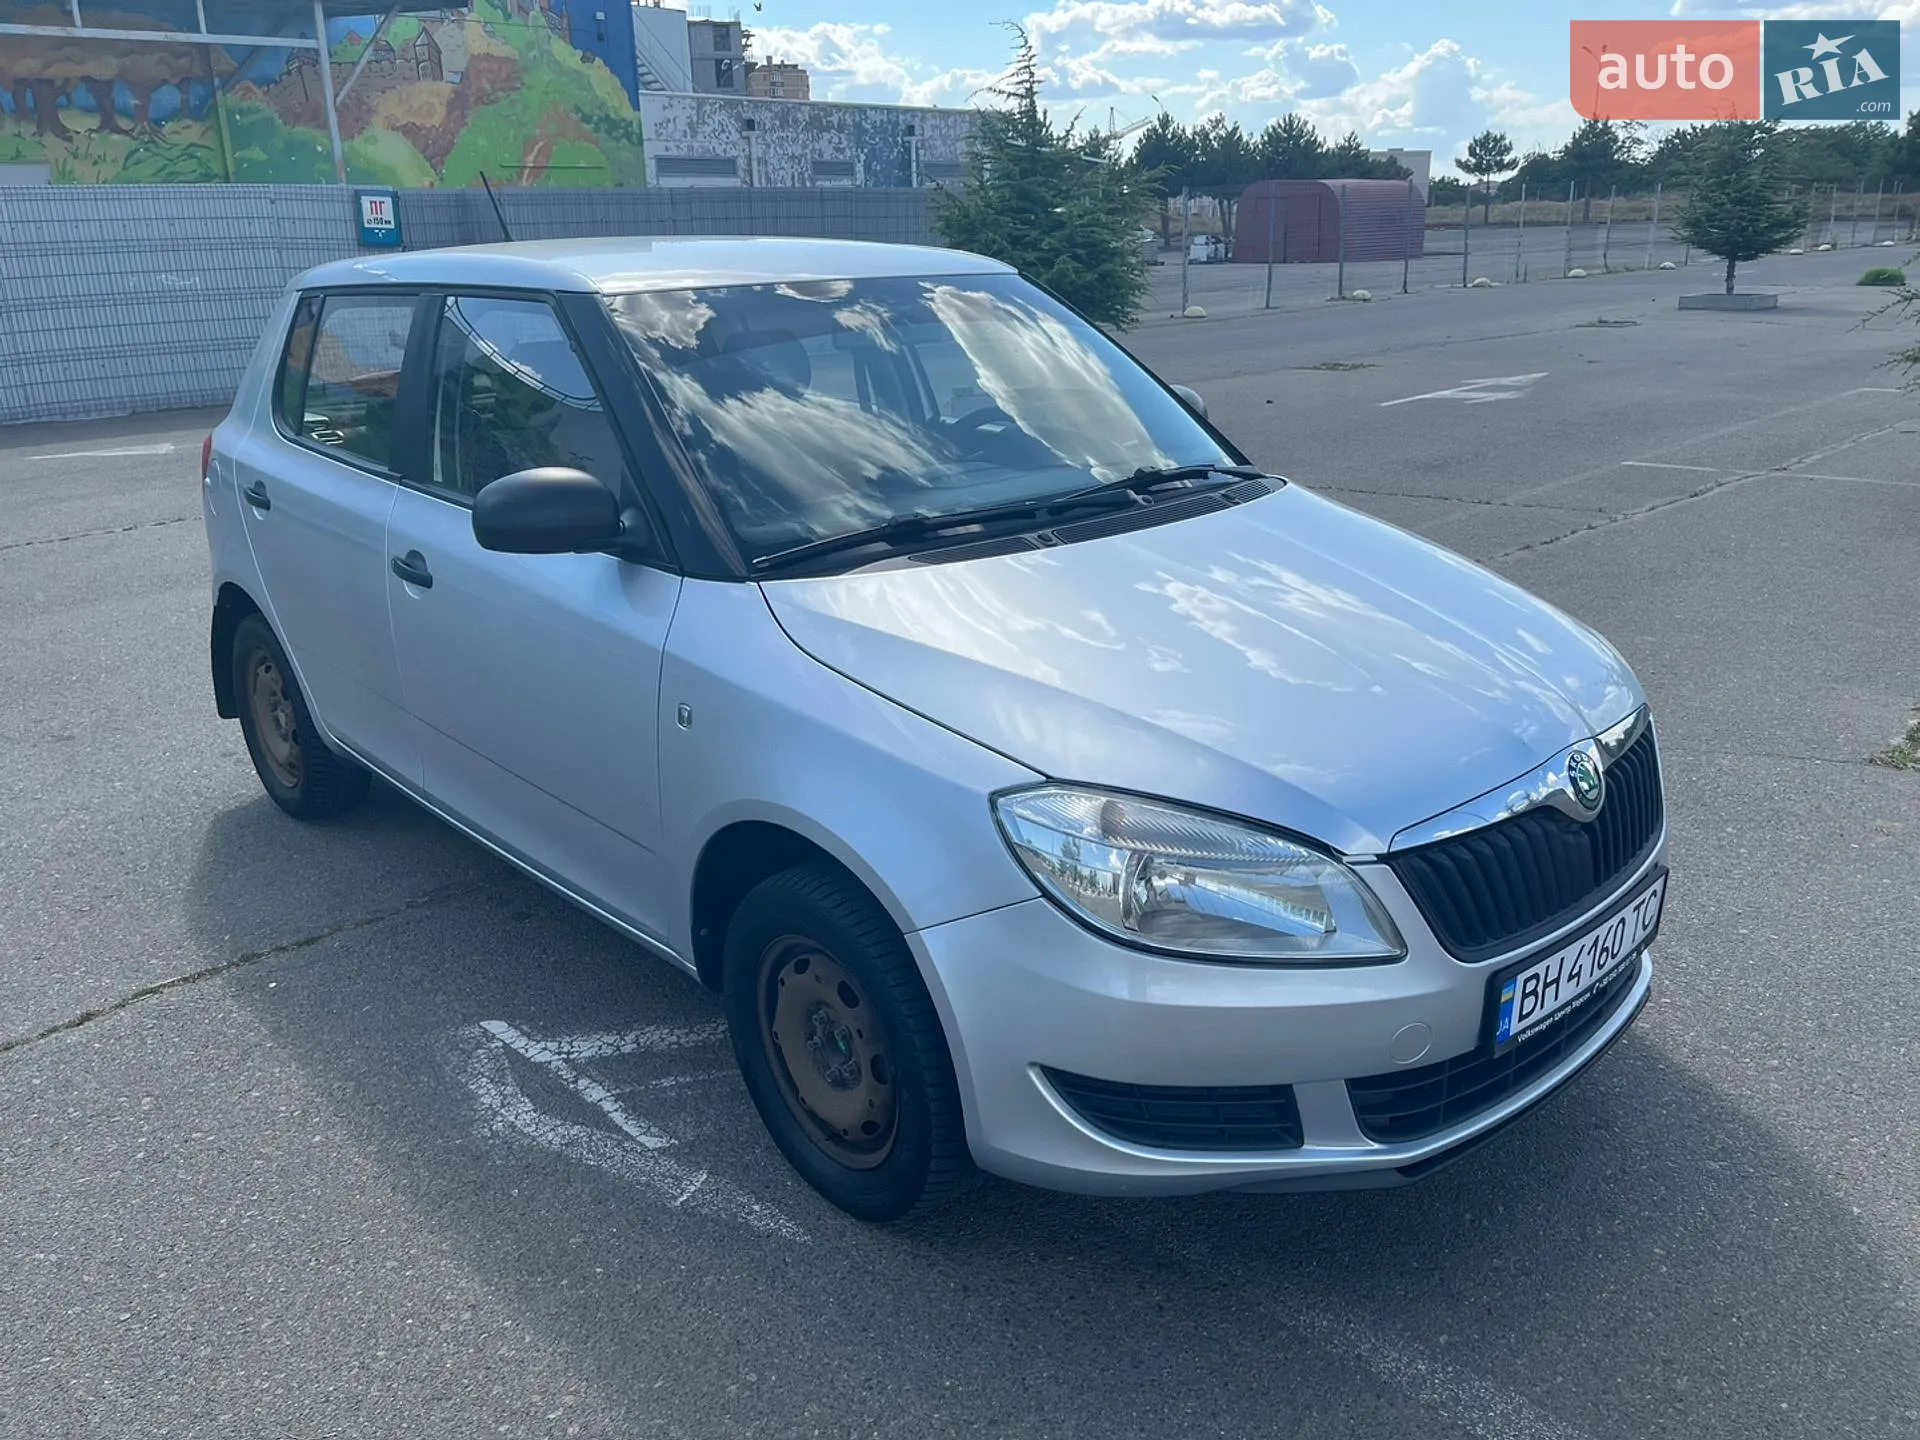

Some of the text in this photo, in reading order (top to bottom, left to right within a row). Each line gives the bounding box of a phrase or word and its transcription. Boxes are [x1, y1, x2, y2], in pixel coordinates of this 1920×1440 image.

[369, 200, 385, 215] ПГ
[1517, 957, 1565, 1024] BH
[1567, 917, 1626, 988] 4160
[1632, 889, 1657, 943] TC
